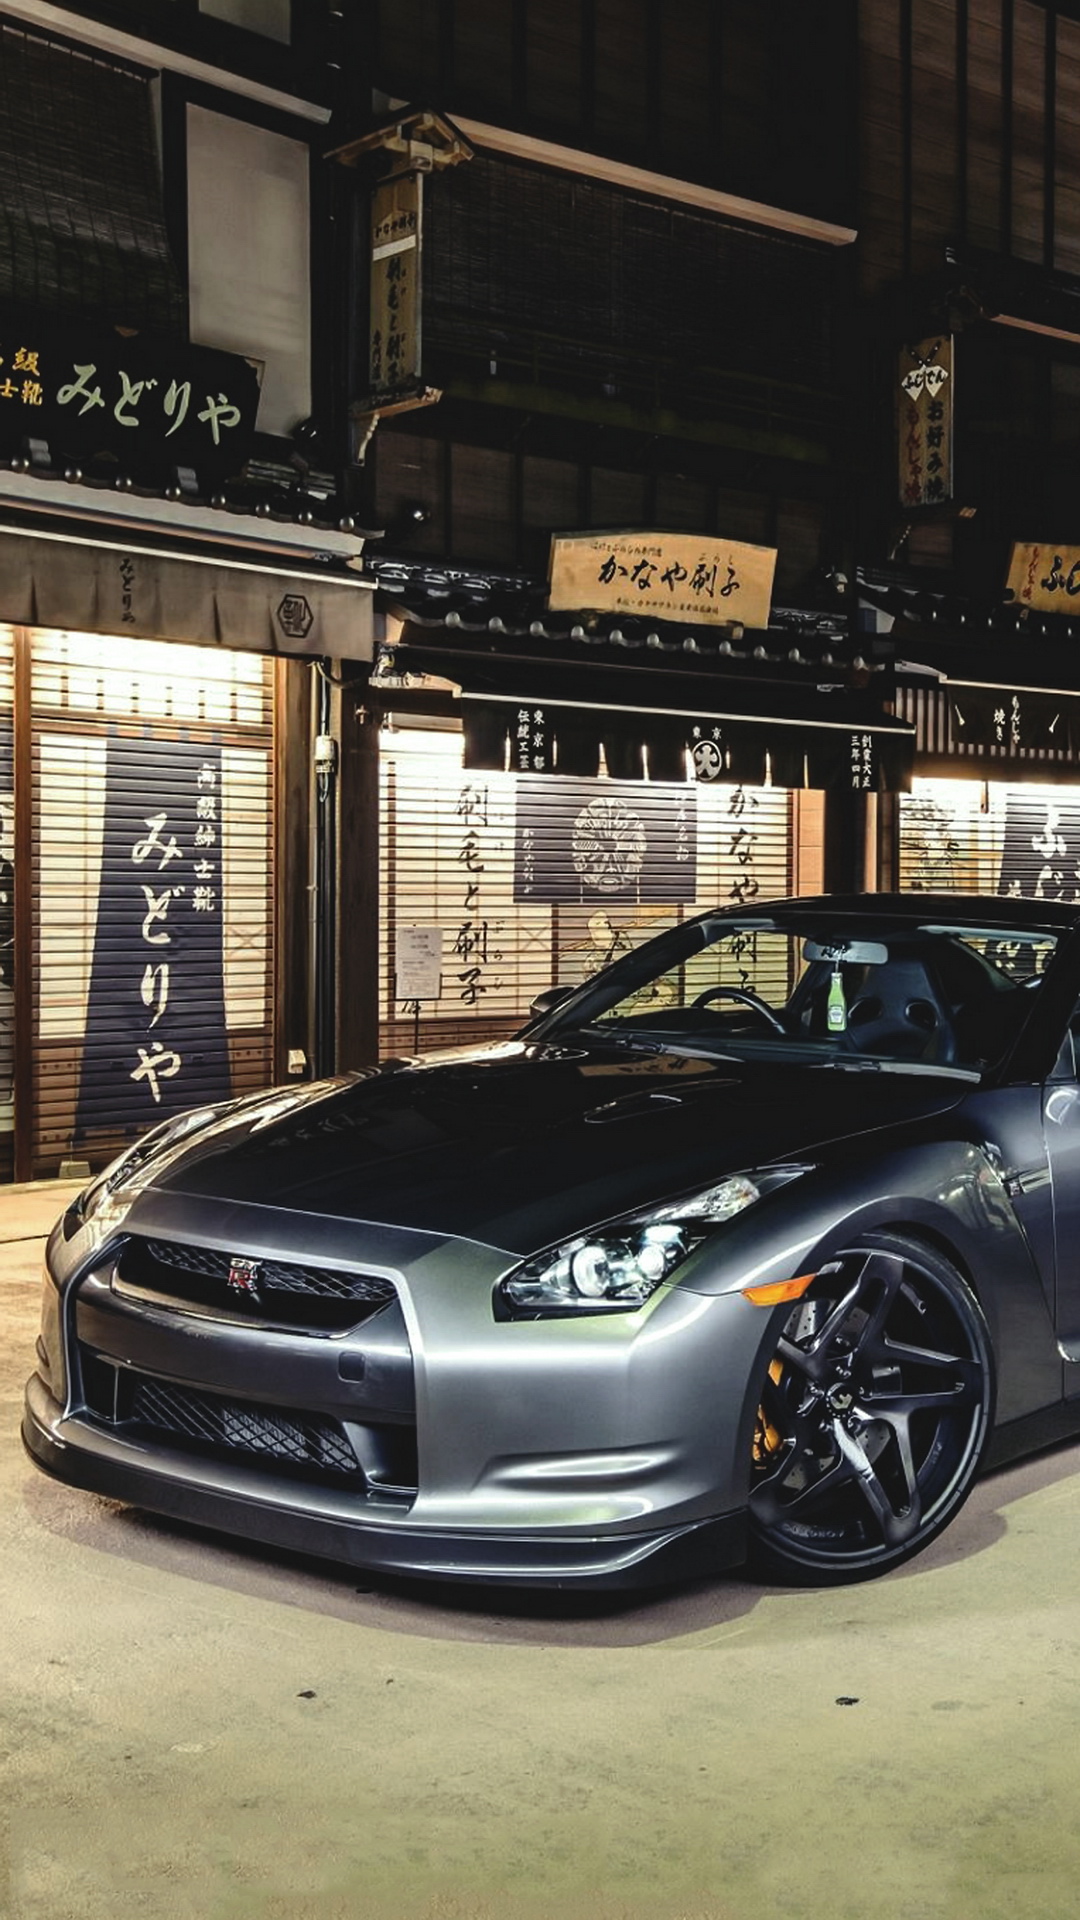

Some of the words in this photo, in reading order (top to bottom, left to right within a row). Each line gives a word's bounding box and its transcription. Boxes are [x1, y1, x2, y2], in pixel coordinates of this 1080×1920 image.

[56, 363, 241, 446] みどりや
[119, 557, 135, 624] みどりや
[598, 554, 741, 598] かなや刷子
[516, 709, 530, 769] 伝統工芸
[533, 709, 545, 770] 東京都
[692, 725, 722, 740] 東京
[851, 735, 861, 788] 三年四月
[130, 812, 187, 1103] みどりや
